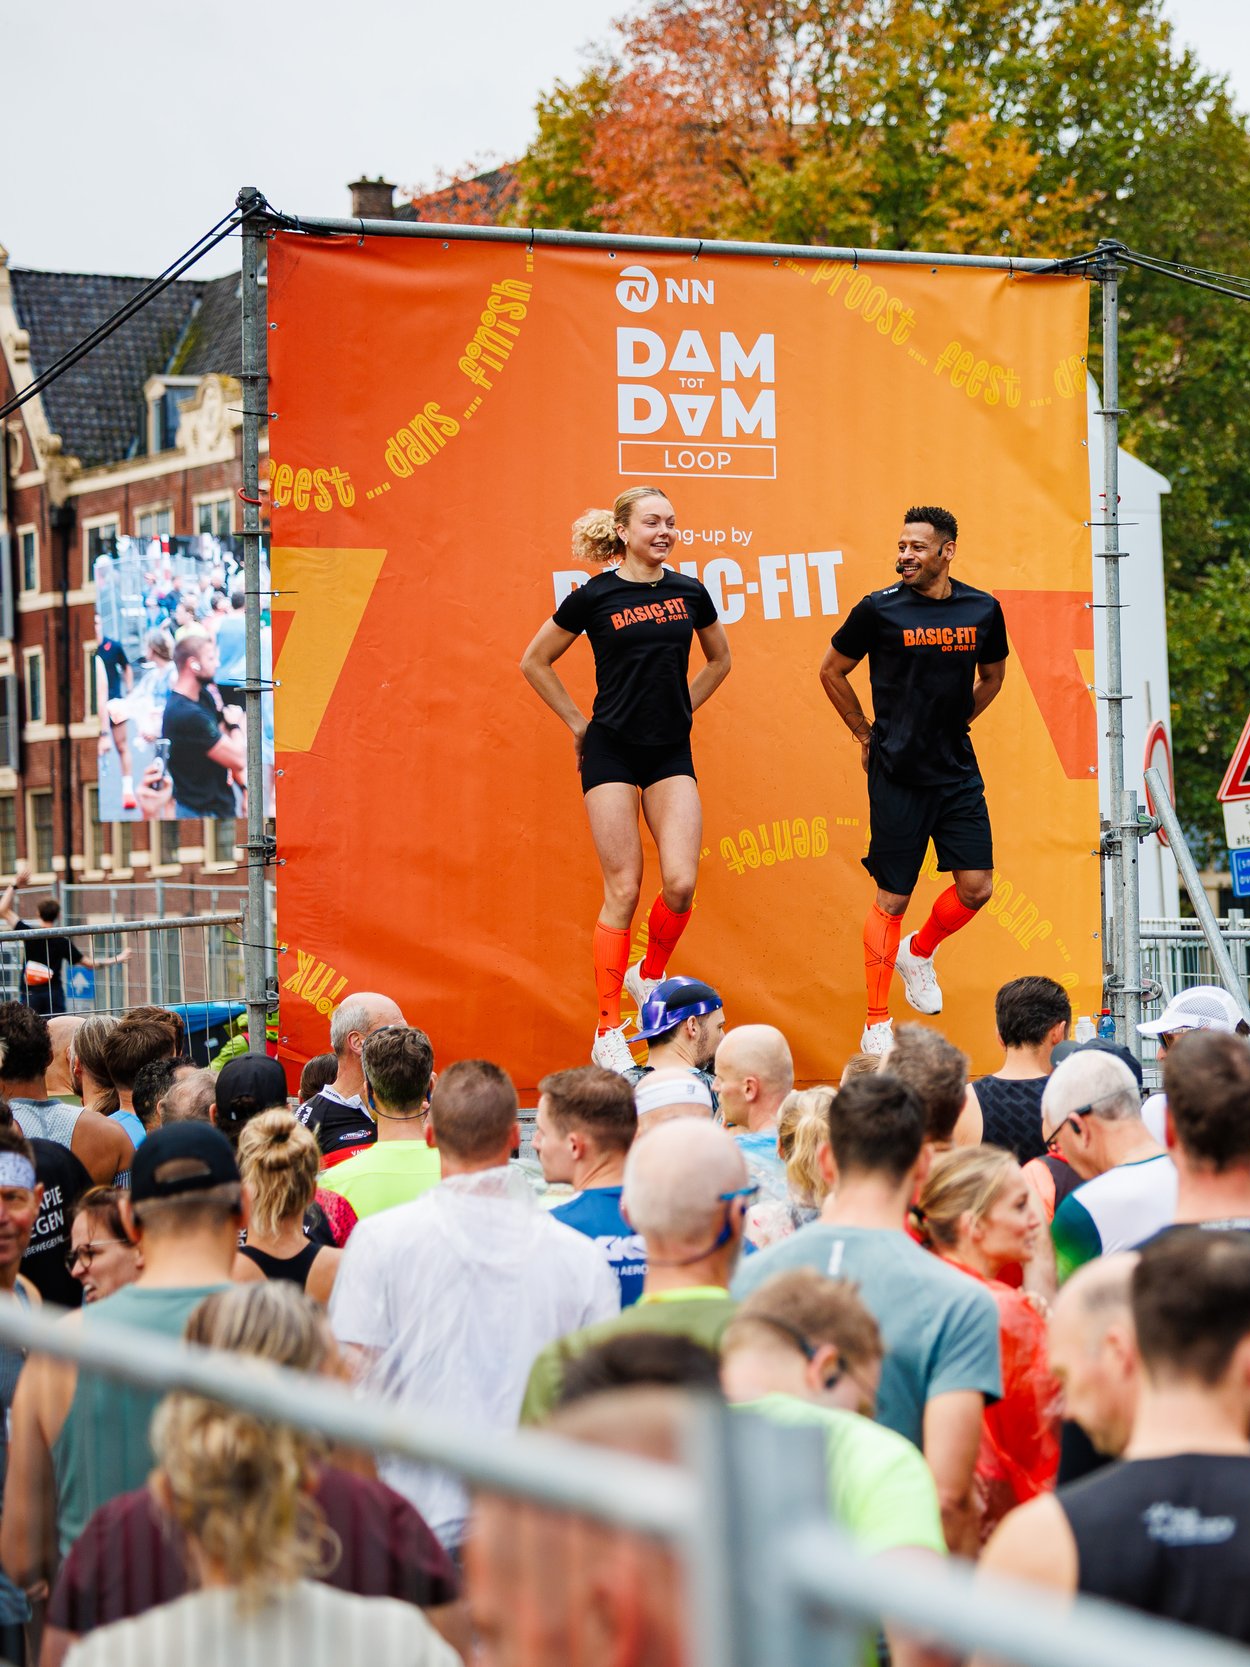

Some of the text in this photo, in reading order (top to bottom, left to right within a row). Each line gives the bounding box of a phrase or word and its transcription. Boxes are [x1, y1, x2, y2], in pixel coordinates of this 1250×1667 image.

[665, 277, 715, 305] NN
[616, 326, 775, 383] DAM
[932, 341, 1022, 408] feest
[268, 278, 533, 512] eest dans finish
[678, 377, 705, 389] TOT
[664, 449, 732, 470] LOOP
[675, 526, 753, 546] ng-up by
[902, 626, 977, 647] BASIC-FIT
[719, 815, 830, 876] geniet
[280, 949, 350, 1021] ink
